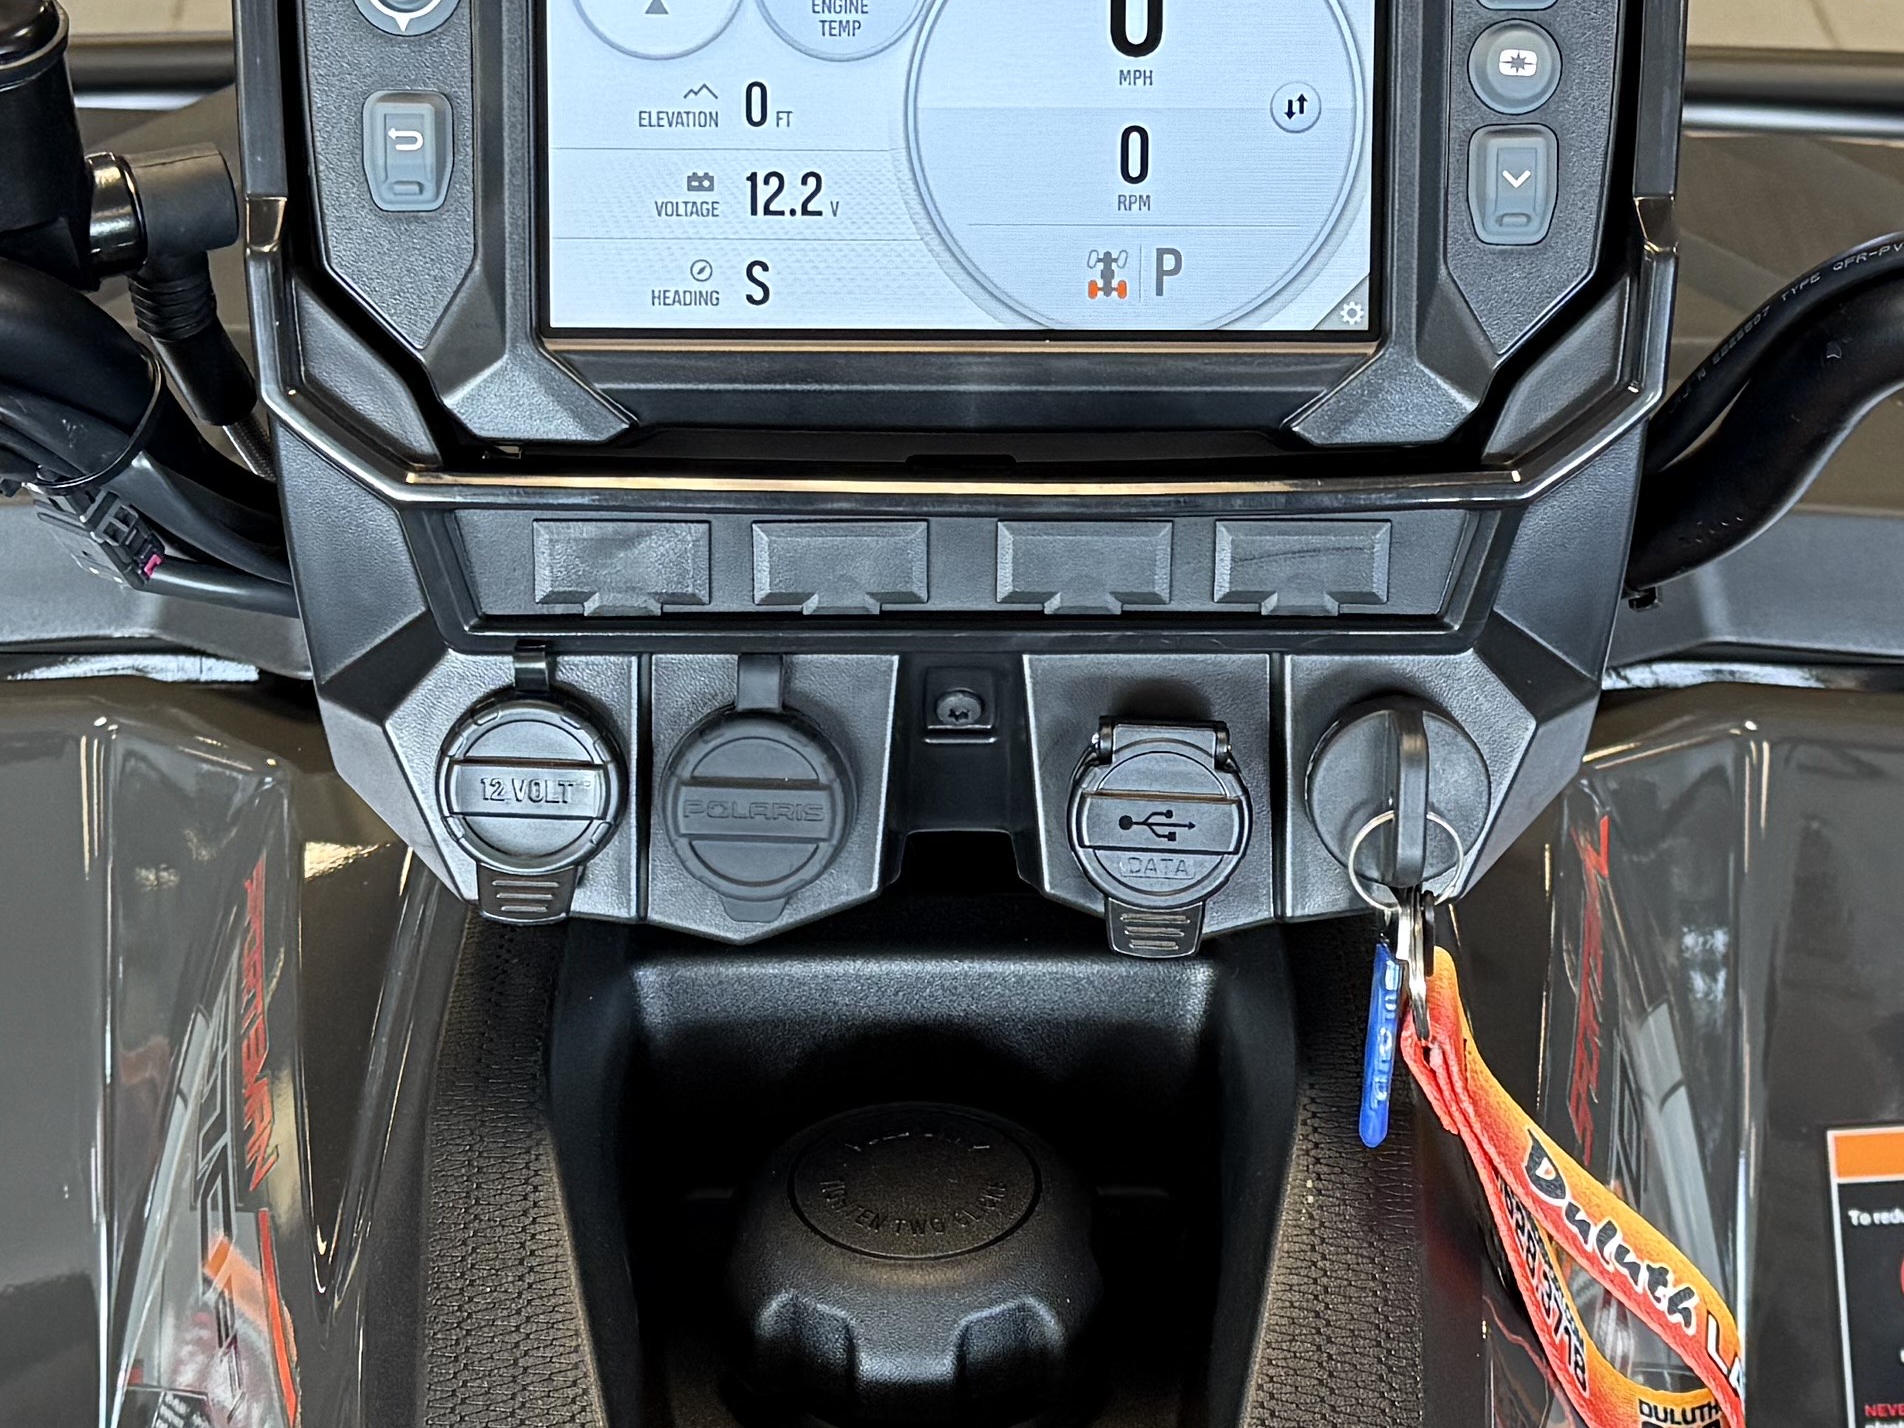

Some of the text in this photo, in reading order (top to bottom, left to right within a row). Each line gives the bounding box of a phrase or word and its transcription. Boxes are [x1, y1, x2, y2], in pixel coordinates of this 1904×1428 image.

[818, 19, 862, 38] TEMP
[1119, 69, 1153, 87] MPH
[638, 81, 793, 128] ELEVATION 0 FT
[1120, 124, 1149, 185] 0
[654, 170, 840, 218] VOLTAGE 12.2 V
[1117, 194, 1151, 212] RPM
[651, 259, 770, 307] HEADING S
[1155, 247, 1183, 297] P
[480, 777, 576, 805] 12 VOLT
[682, 799, 827, 822] POLARIS
[1127, 856, 1189, 876] DATA
[1525, 1128, 1699, 1335] Duluth
